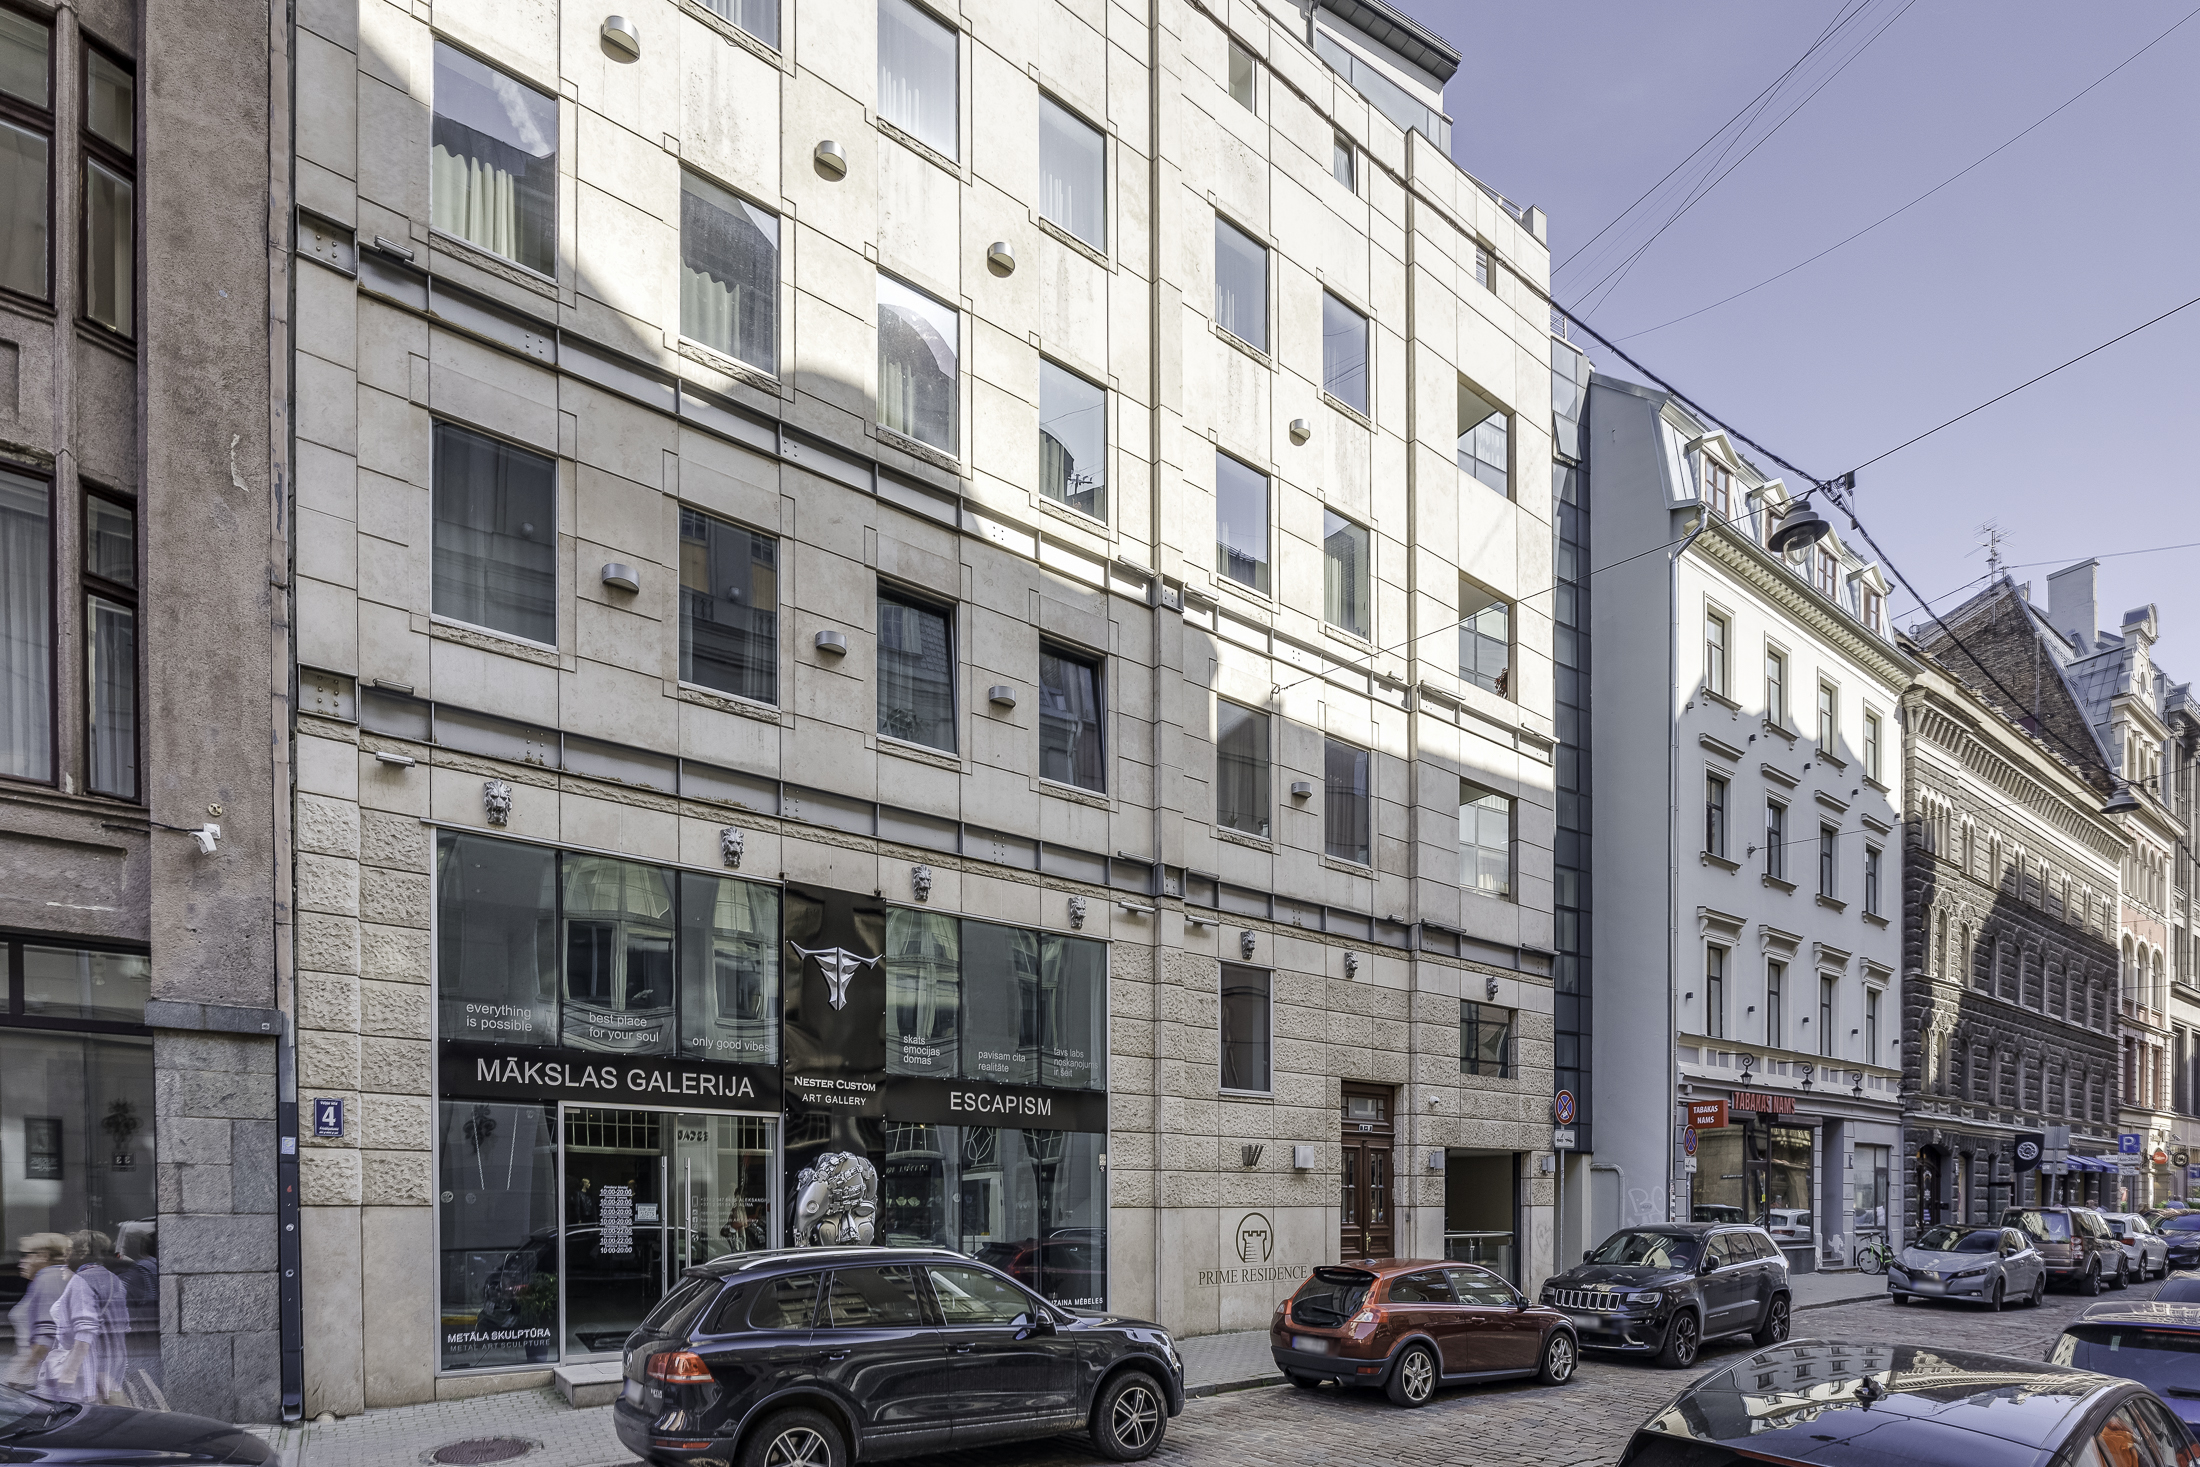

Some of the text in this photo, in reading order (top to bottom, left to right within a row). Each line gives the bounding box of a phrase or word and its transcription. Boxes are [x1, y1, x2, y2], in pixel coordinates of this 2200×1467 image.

[466, 1003, 531, 1020] everything
[466, 1015, 533, 1032] is possible
[589, 1011, 647, 1028] best place
[589, 1026, 659, 1043] for your soul
[903, 1034, 926, 1046] skats
[692, 1036, 770, 1052] only good vibes
[903, 1045, 941, 1057] emocijas
[903, 1053, 932, 1066] domas
[978, 1050, 1026, 1063] pavisam cita
[1053, 1047, 1085, 1059] tavs labs
[978, 1062, 1009, 1073] realitāte
[1053, 1067, 1059, 1076] ir
[477, 1056, 755, 1098] MĀKSLAS GALERIJA
[802, 1093, 866, 1106] ART GALLERY
[950, 1091, 1052, 1116] ESCAPISM
[1734, 1091, 1796, 1114] TABAKAS NAMS
[322, 1106, 336, 1127] 4
[1693, 1105, 1719, 1114] TABAKAS
[1697, 1116, 1714, 1124] NAMS
[1199, 1265, 1308, 1286] PRIME RESIDENCE
[447, 1327, 551, 1343] METĀLA SKULPTŪRA
[450, 1339, 550, 1352] METAL ART SCULPTURE
